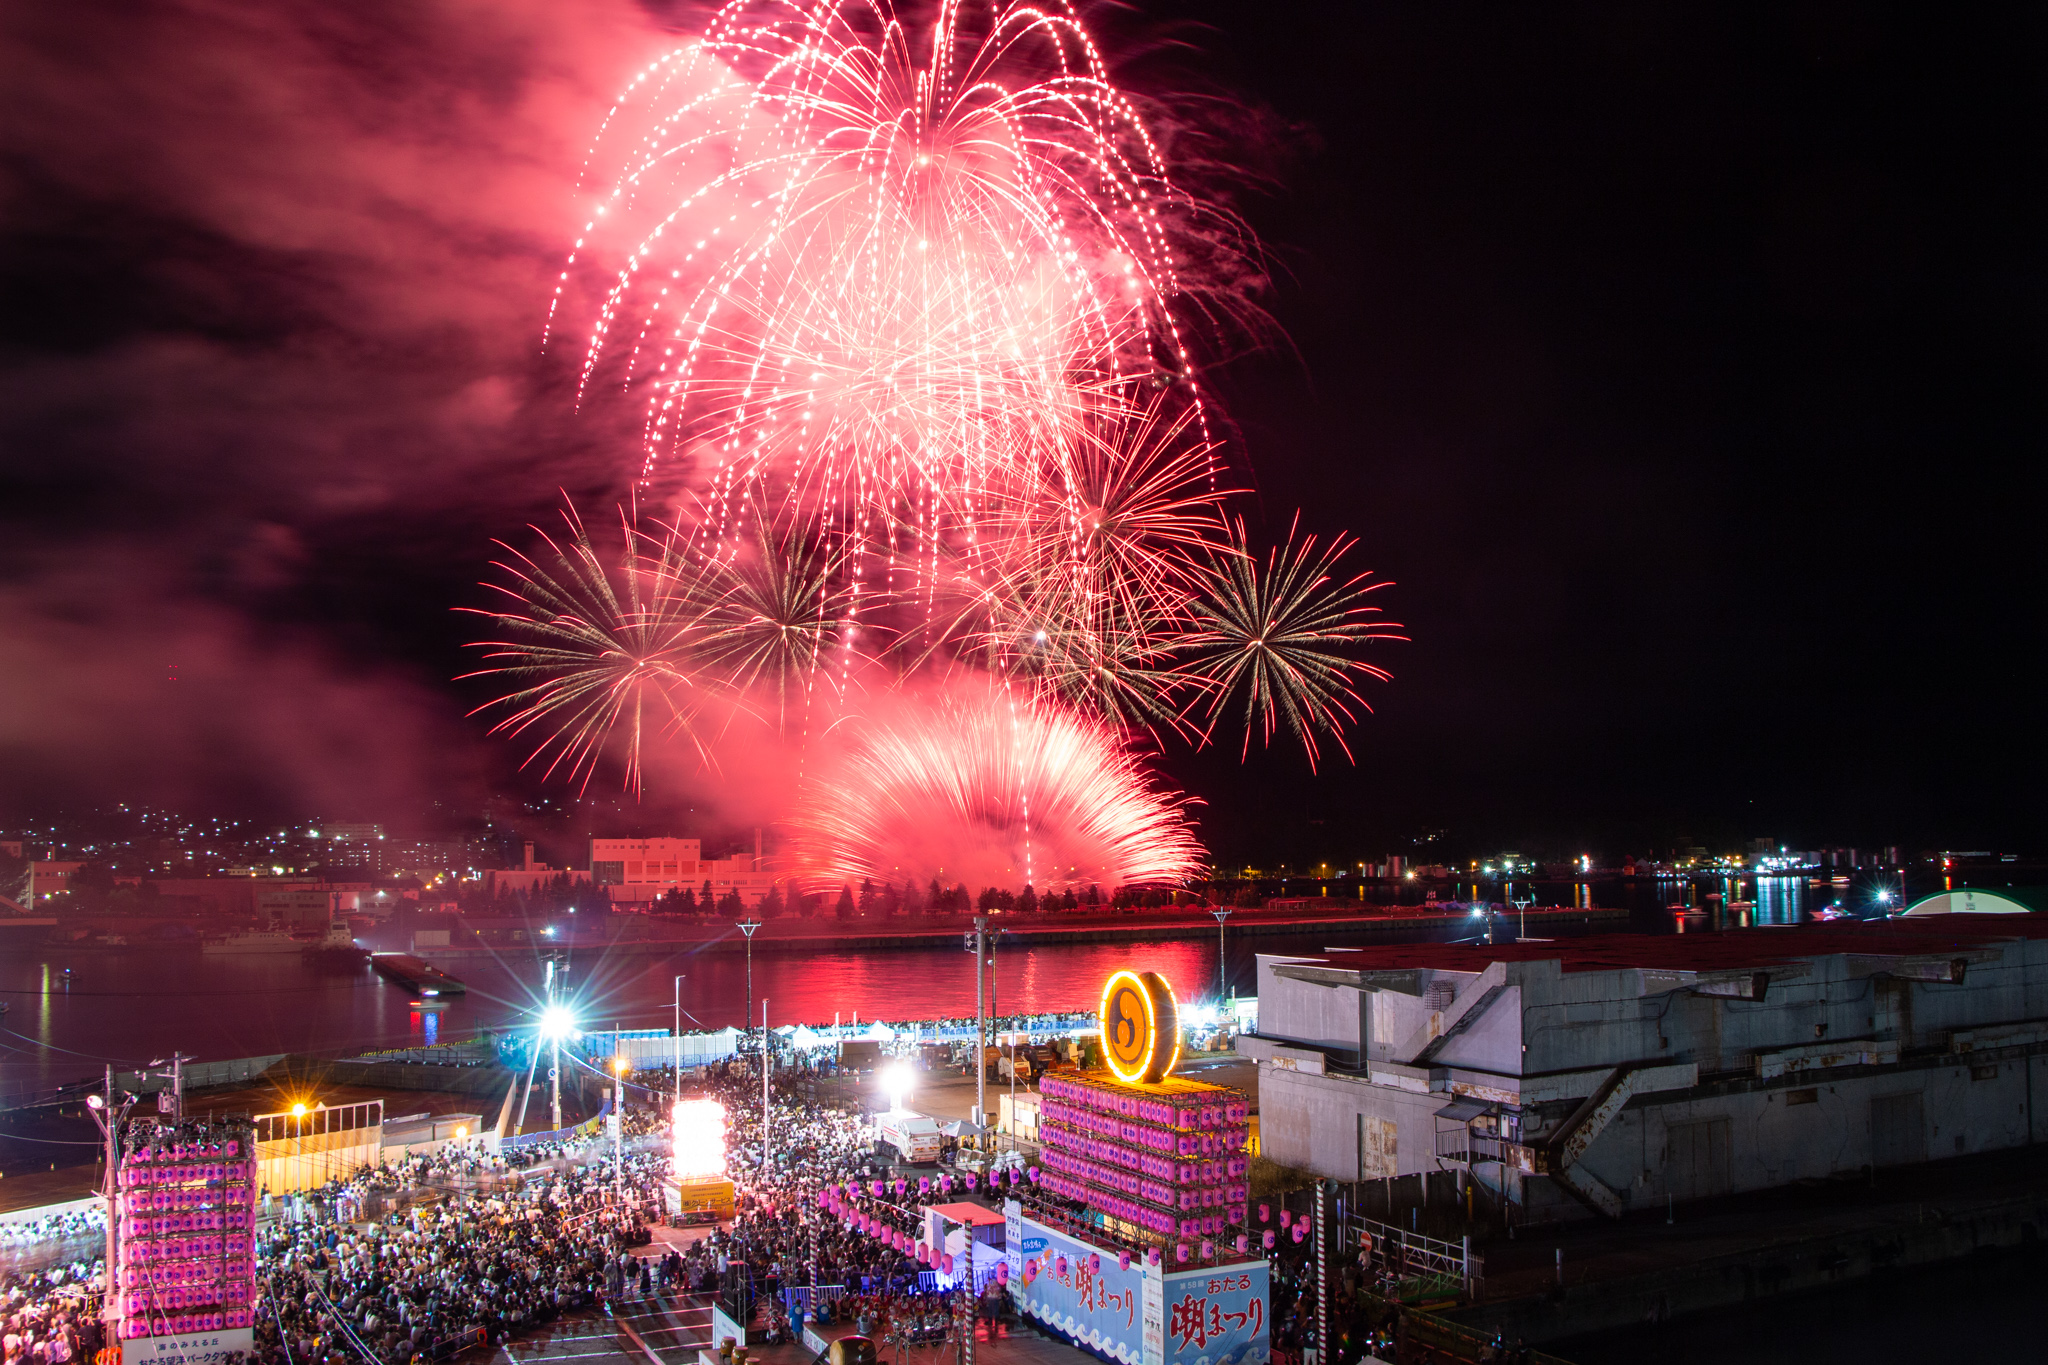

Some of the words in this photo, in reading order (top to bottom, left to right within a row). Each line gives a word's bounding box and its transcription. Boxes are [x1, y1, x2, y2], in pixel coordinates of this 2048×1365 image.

[1207, 1274, 1251, 1294] おたる
[158, 1338, 220, 1351] 海のみえる丘
